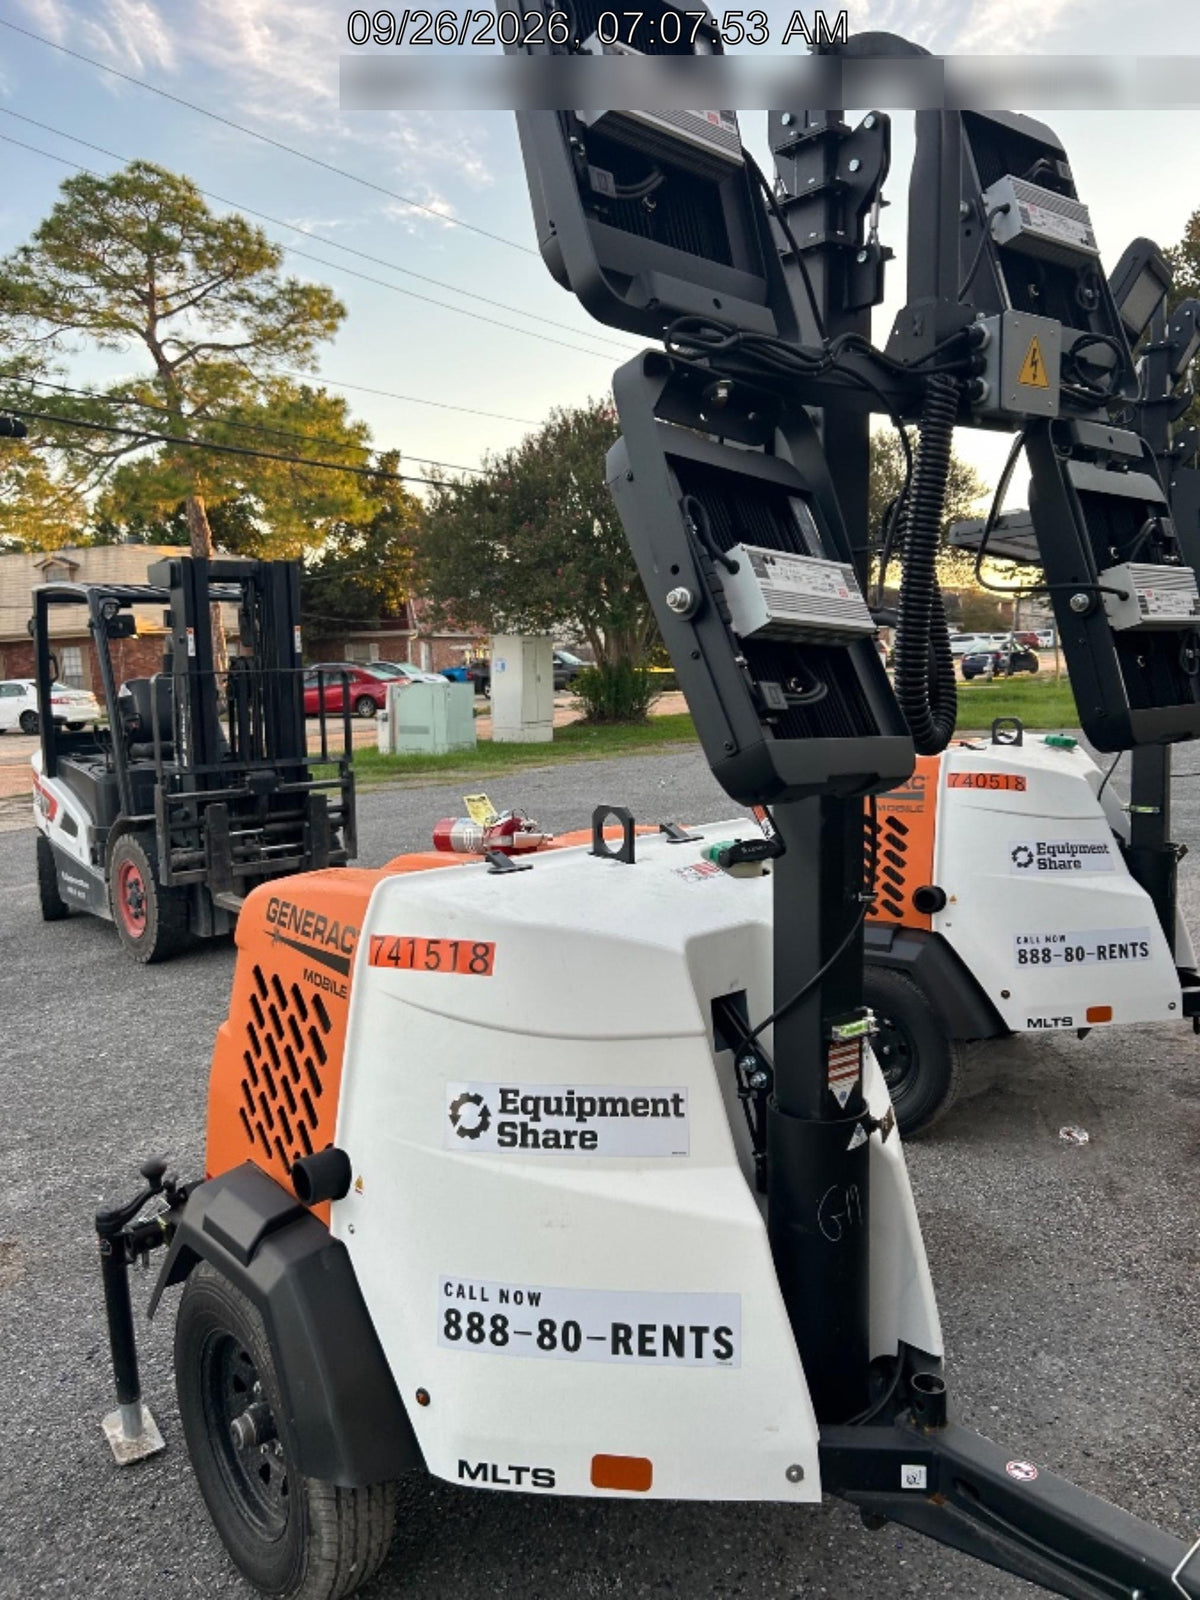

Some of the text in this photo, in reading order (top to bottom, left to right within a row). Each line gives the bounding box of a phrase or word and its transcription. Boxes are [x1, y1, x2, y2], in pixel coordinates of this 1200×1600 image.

[948, 773, 1025, 791] 740518
[1036, 842, 1110, 857] Equipment
[1036, 857, 1081, 870] Share
[266, 897, 356, 955] GENERAC
[1016, 934, 1066, 945] CALL NOW
[373, 936, 490, 974] 741518
[1017, 942, 1149, 965] 888-80-RENTS
[303, 968, 348, 999] MOBILE
[1027, 1016, 1073, 1028] MLTS
[499, 1088, 685, 1123] Equipment
[497, 1121, 598, 1151] Share
[443, 1281, 542, 1307] CALL NOW
[443, 1307, 734, 1361] 888-80-RENTS
[458, 1459, 556, 1489] MLTS
